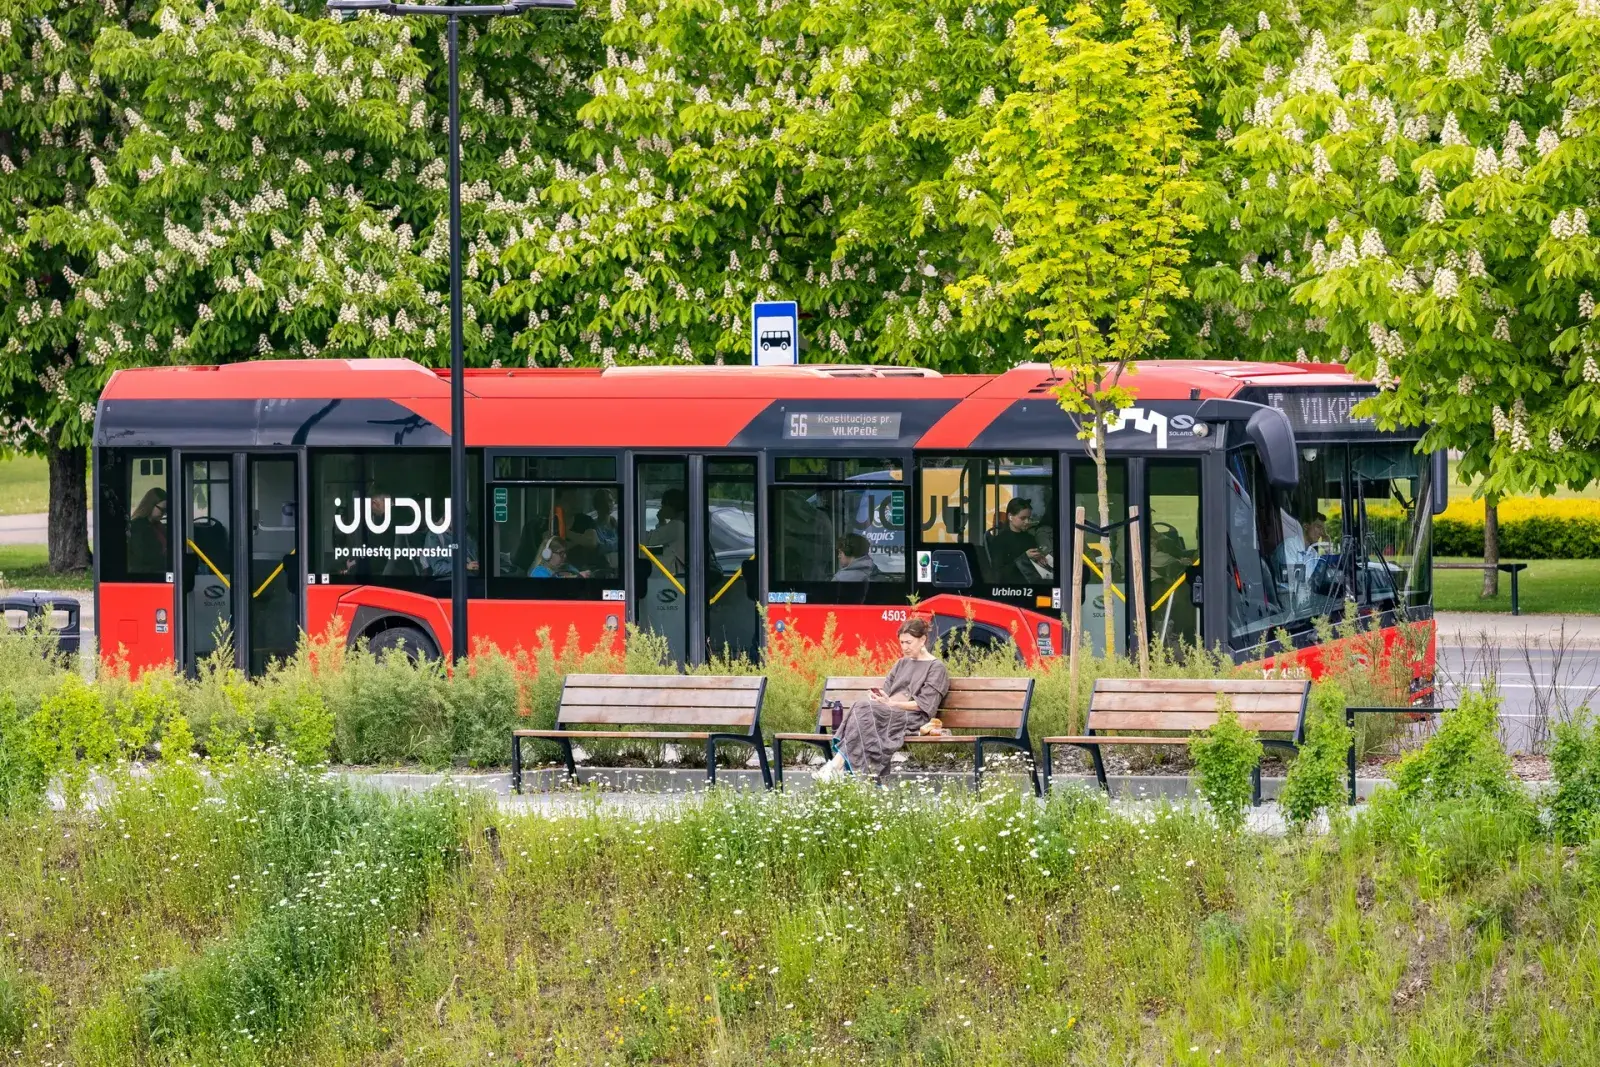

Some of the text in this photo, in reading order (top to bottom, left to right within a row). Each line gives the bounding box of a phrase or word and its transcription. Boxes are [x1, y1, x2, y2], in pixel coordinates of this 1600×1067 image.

[790, 413, 808, 437] 56
[817, 413, 892, 425] Konstitucijos pr.
[334, 497, 452, 535] JUDU
[334, 543, 453, 560] po miestą paprastai
[992, 587, 1034, 597] Urbino 12
[881, 609, 907, 621] 4503
